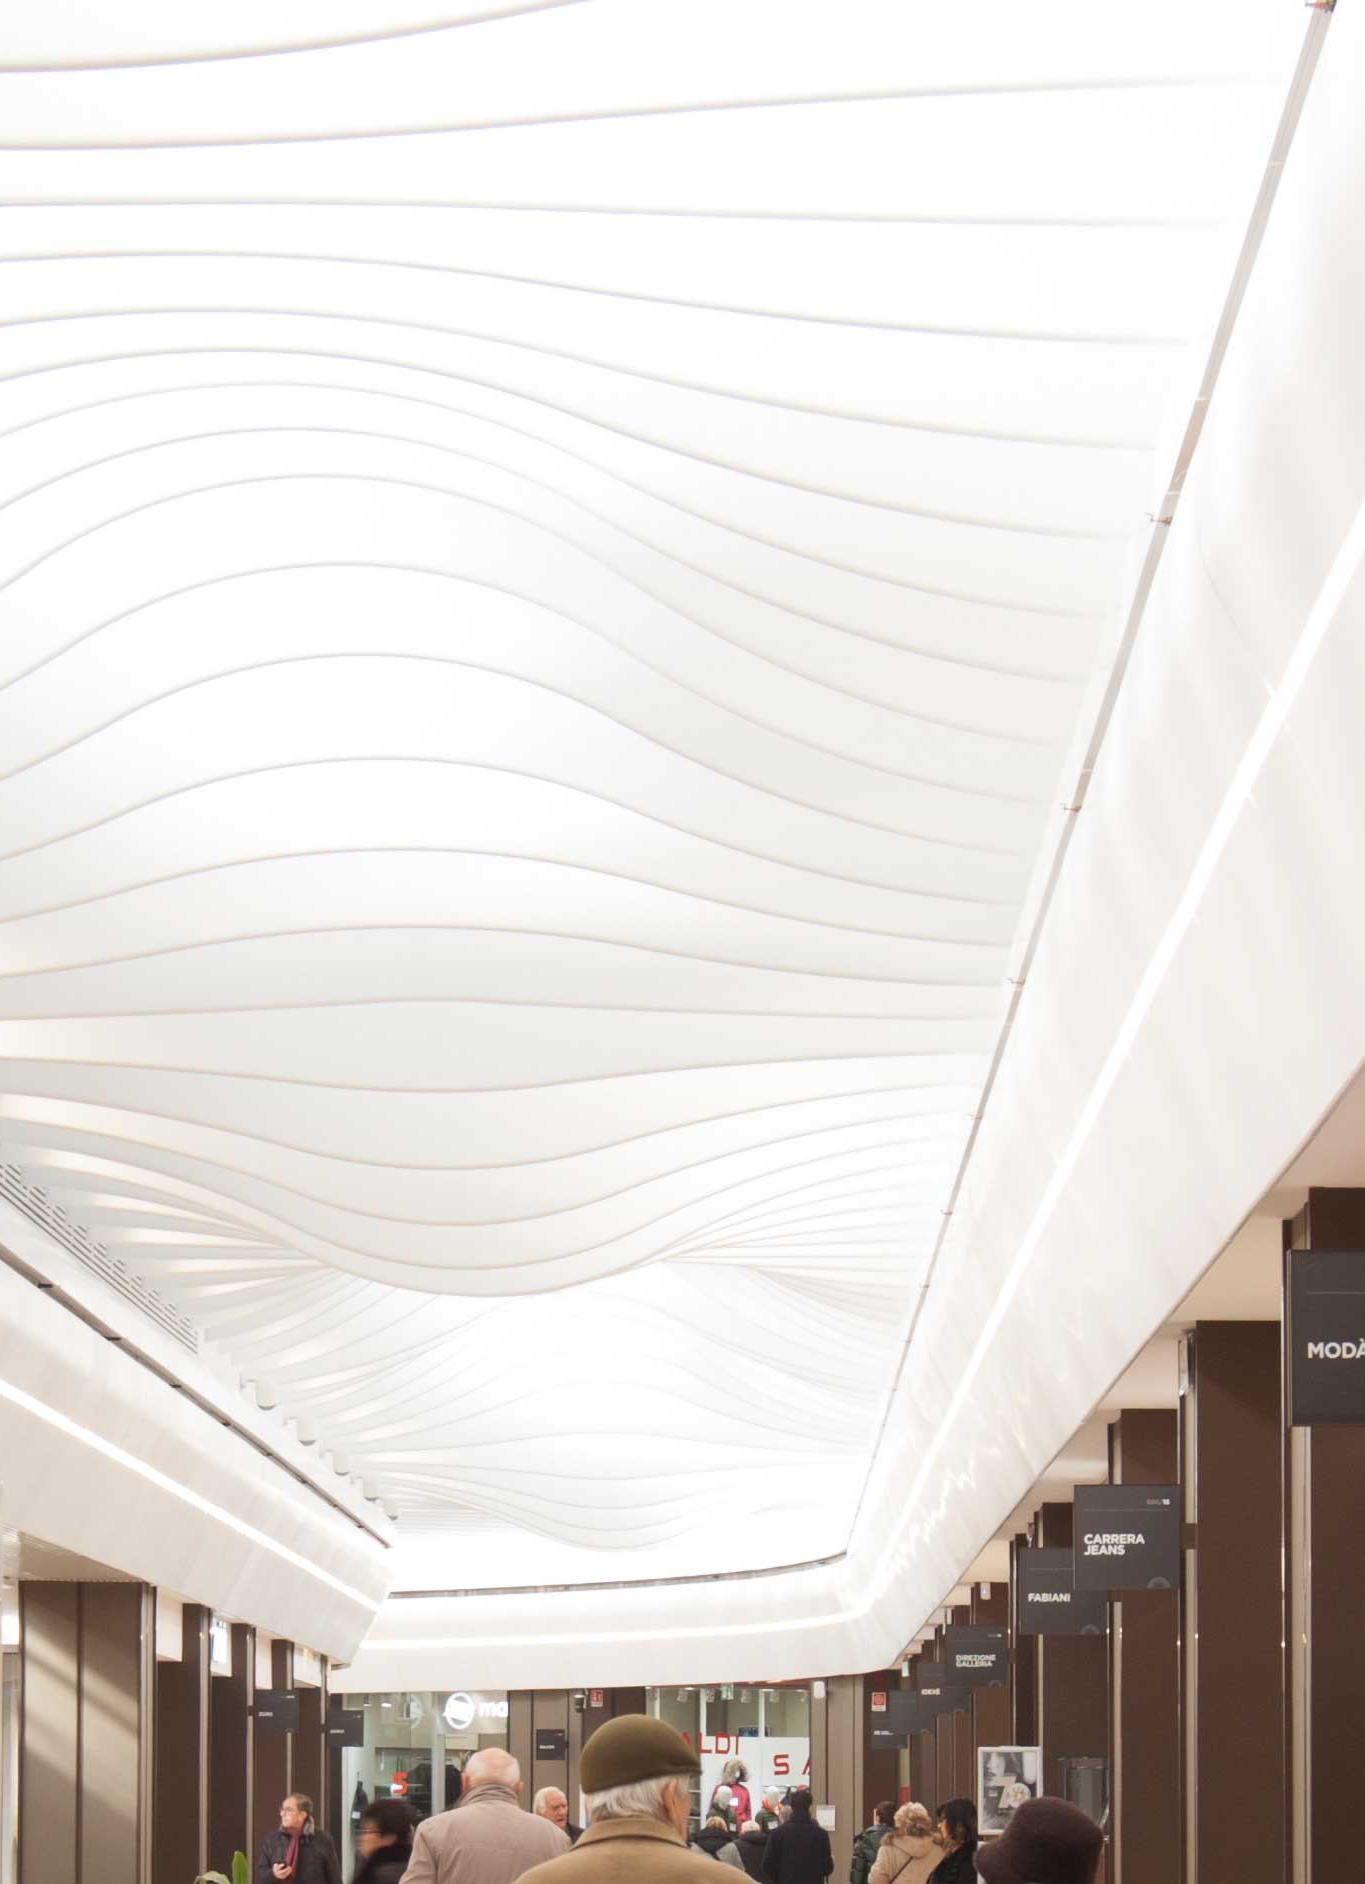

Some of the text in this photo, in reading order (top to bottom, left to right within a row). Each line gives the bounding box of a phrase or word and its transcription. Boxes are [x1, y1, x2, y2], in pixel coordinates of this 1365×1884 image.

[1083, 1533, 1145, 1545] CARRERA
[1083, 1545, 1126, 1556] JEANS
[1027, 1593, 1071, 1603] FABIANI
